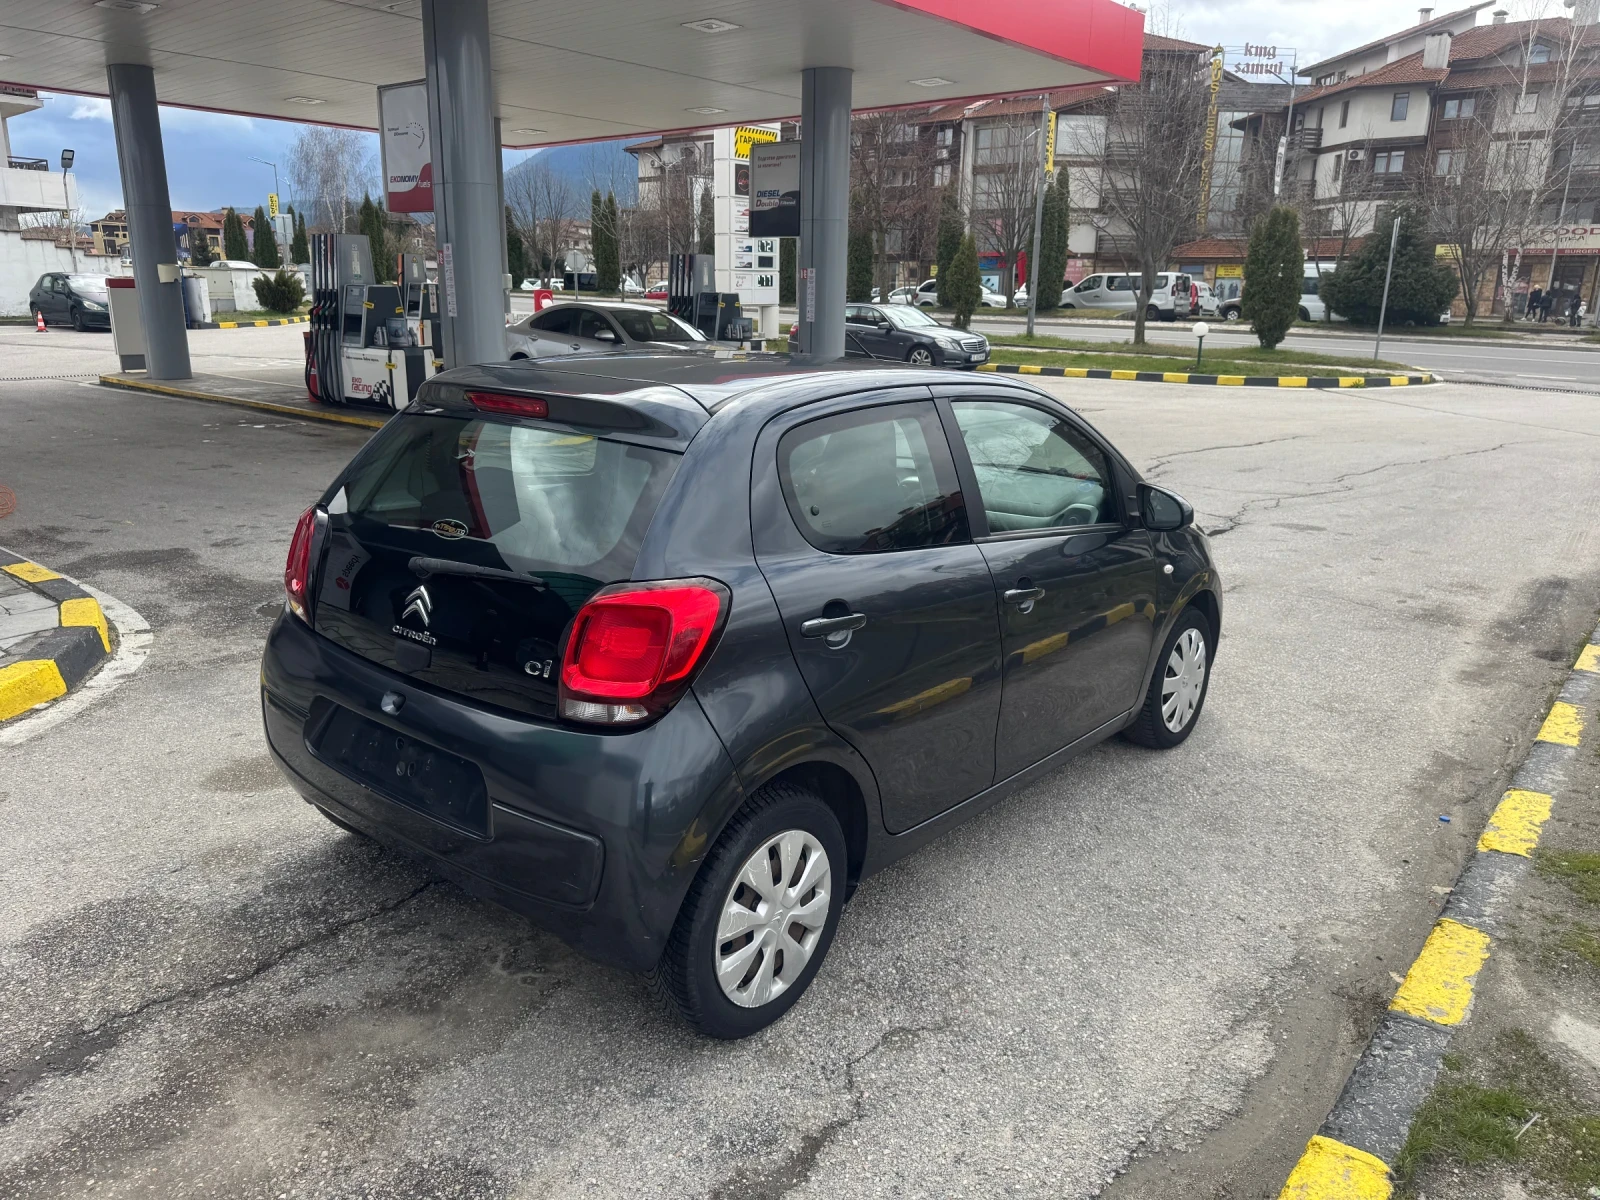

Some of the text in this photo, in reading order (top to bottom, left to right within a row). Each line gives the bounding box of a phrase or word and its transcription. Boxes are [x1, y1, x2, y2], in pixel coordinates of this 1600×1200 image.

[390, 175, 419, 183] EKONOMY
[418, 180, 431, 188] fuels
[756, 189, 780, 198] DIESEL
[755, 199, 779, 208] Double
[351, 383, 373, 395] racing
[524, 659, 553, 678] C1
